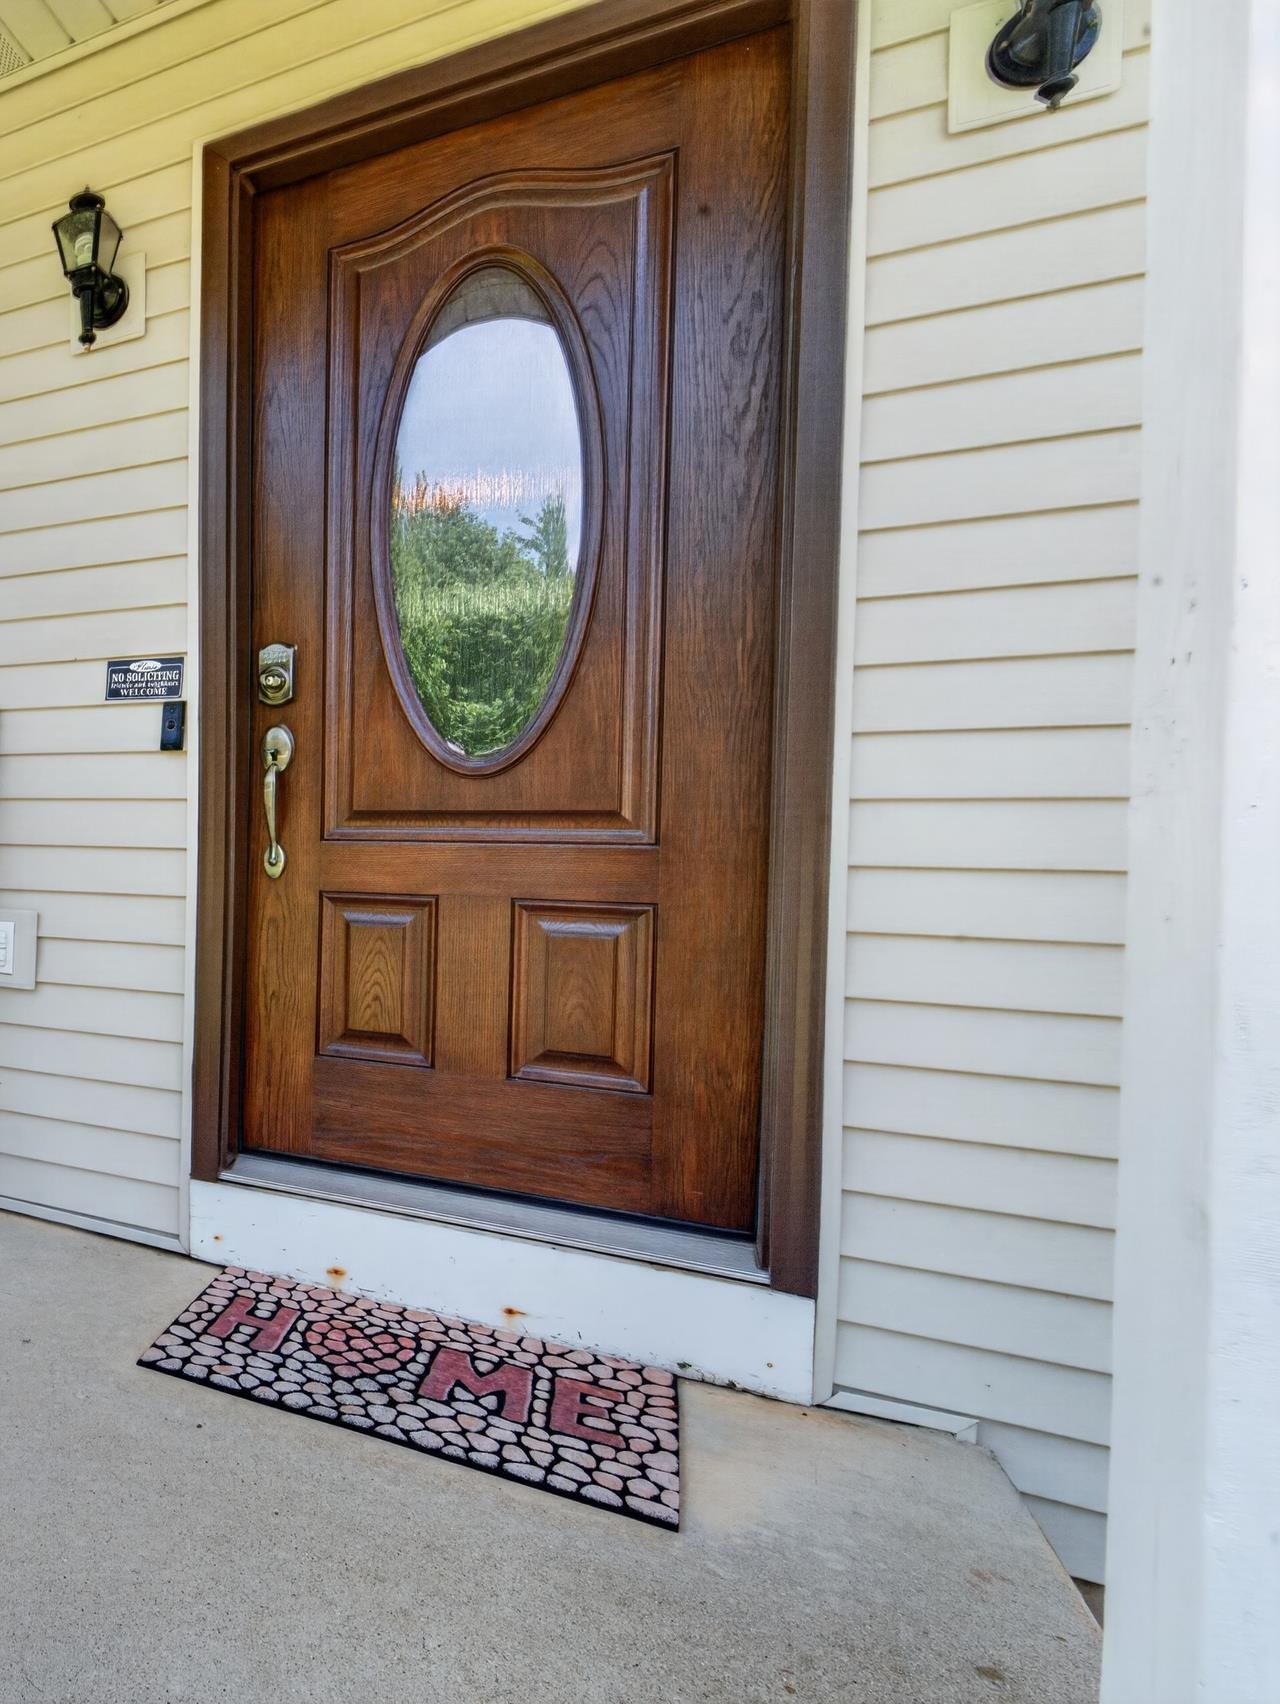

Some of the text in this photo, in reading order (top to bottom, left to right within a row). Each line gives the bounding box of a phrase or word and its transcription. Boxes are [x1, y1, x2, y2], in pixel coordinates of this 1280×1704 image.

[112, 671, 179, 682] NO SOLICITING
[121, 688, 167, 696] WELCOME
[207, 1296, 626, 1448] HME
